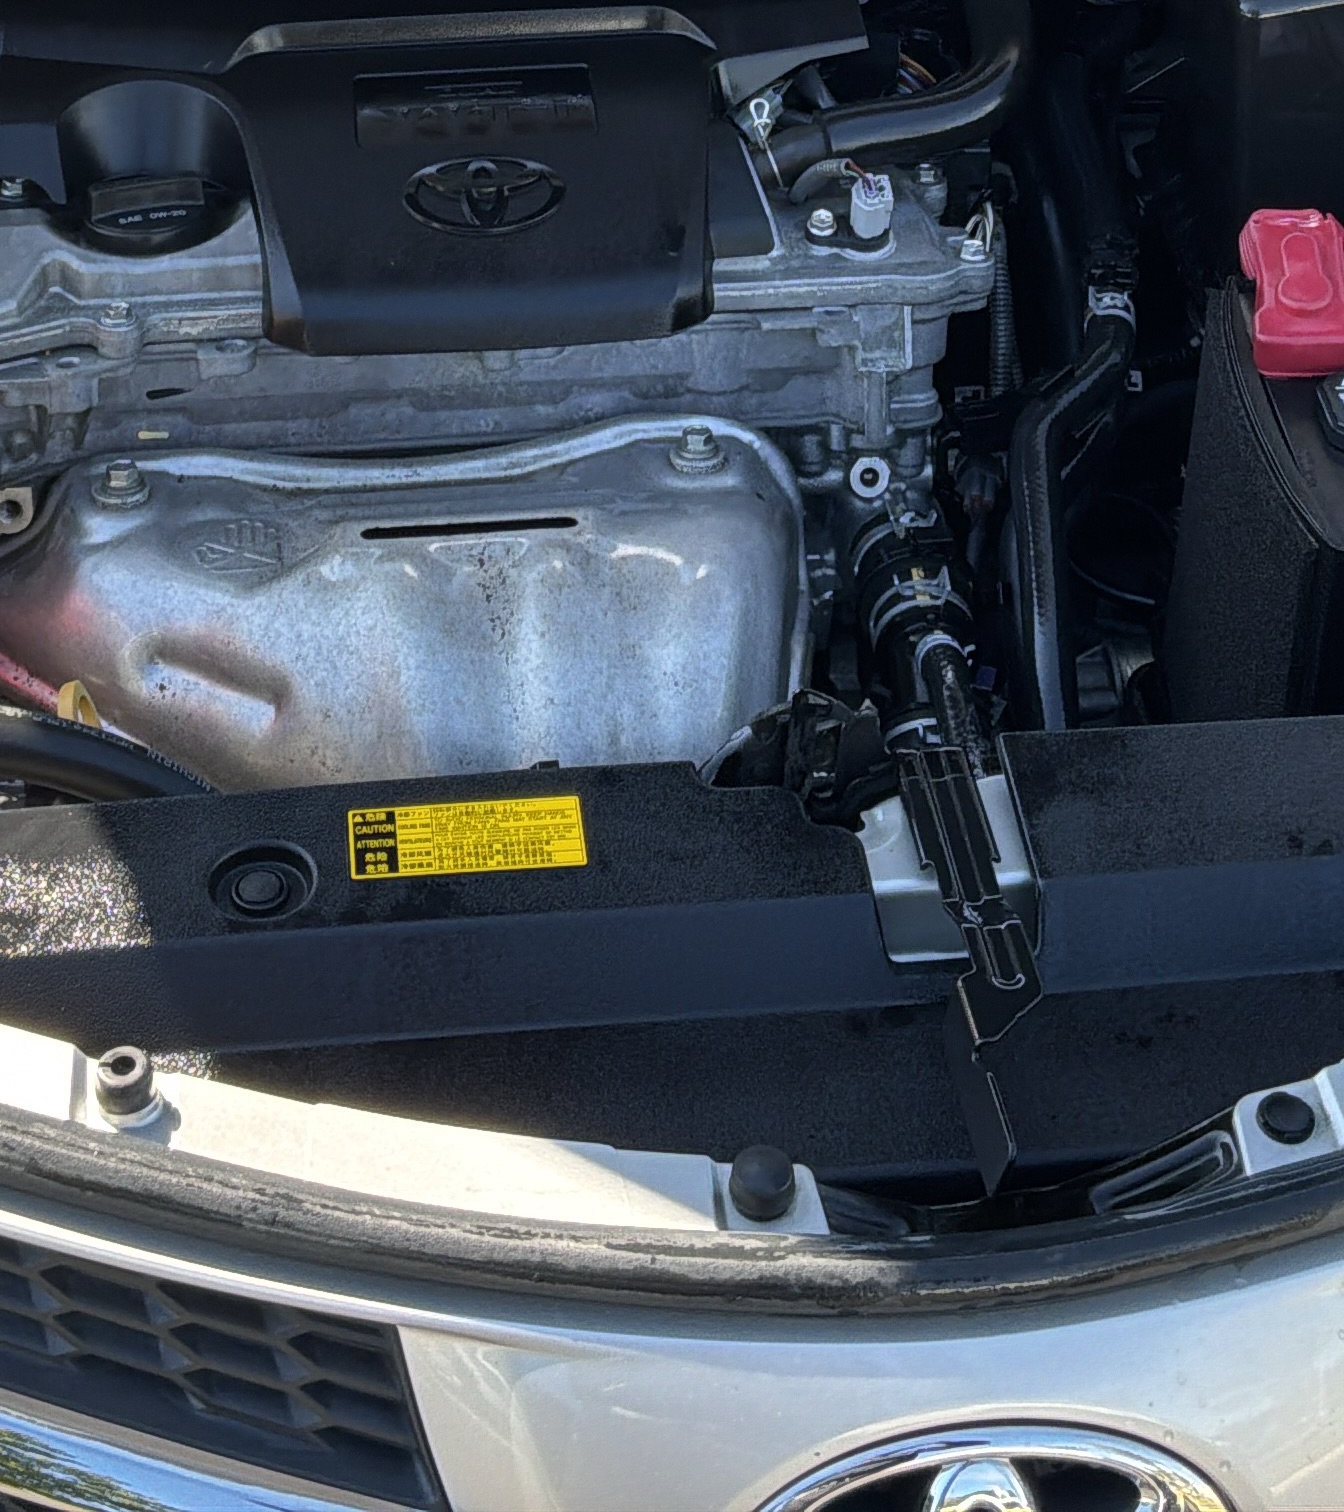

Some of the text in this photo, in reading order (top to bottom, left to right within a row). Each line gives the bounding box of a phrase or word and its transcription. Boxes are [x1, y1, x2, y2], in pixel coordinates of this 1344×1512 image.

[118, 209, 187, 225] SAE 0W-20
[355, 823, 395, 835] CAUTION
[357, 838, 396, 849] ATTENTION
